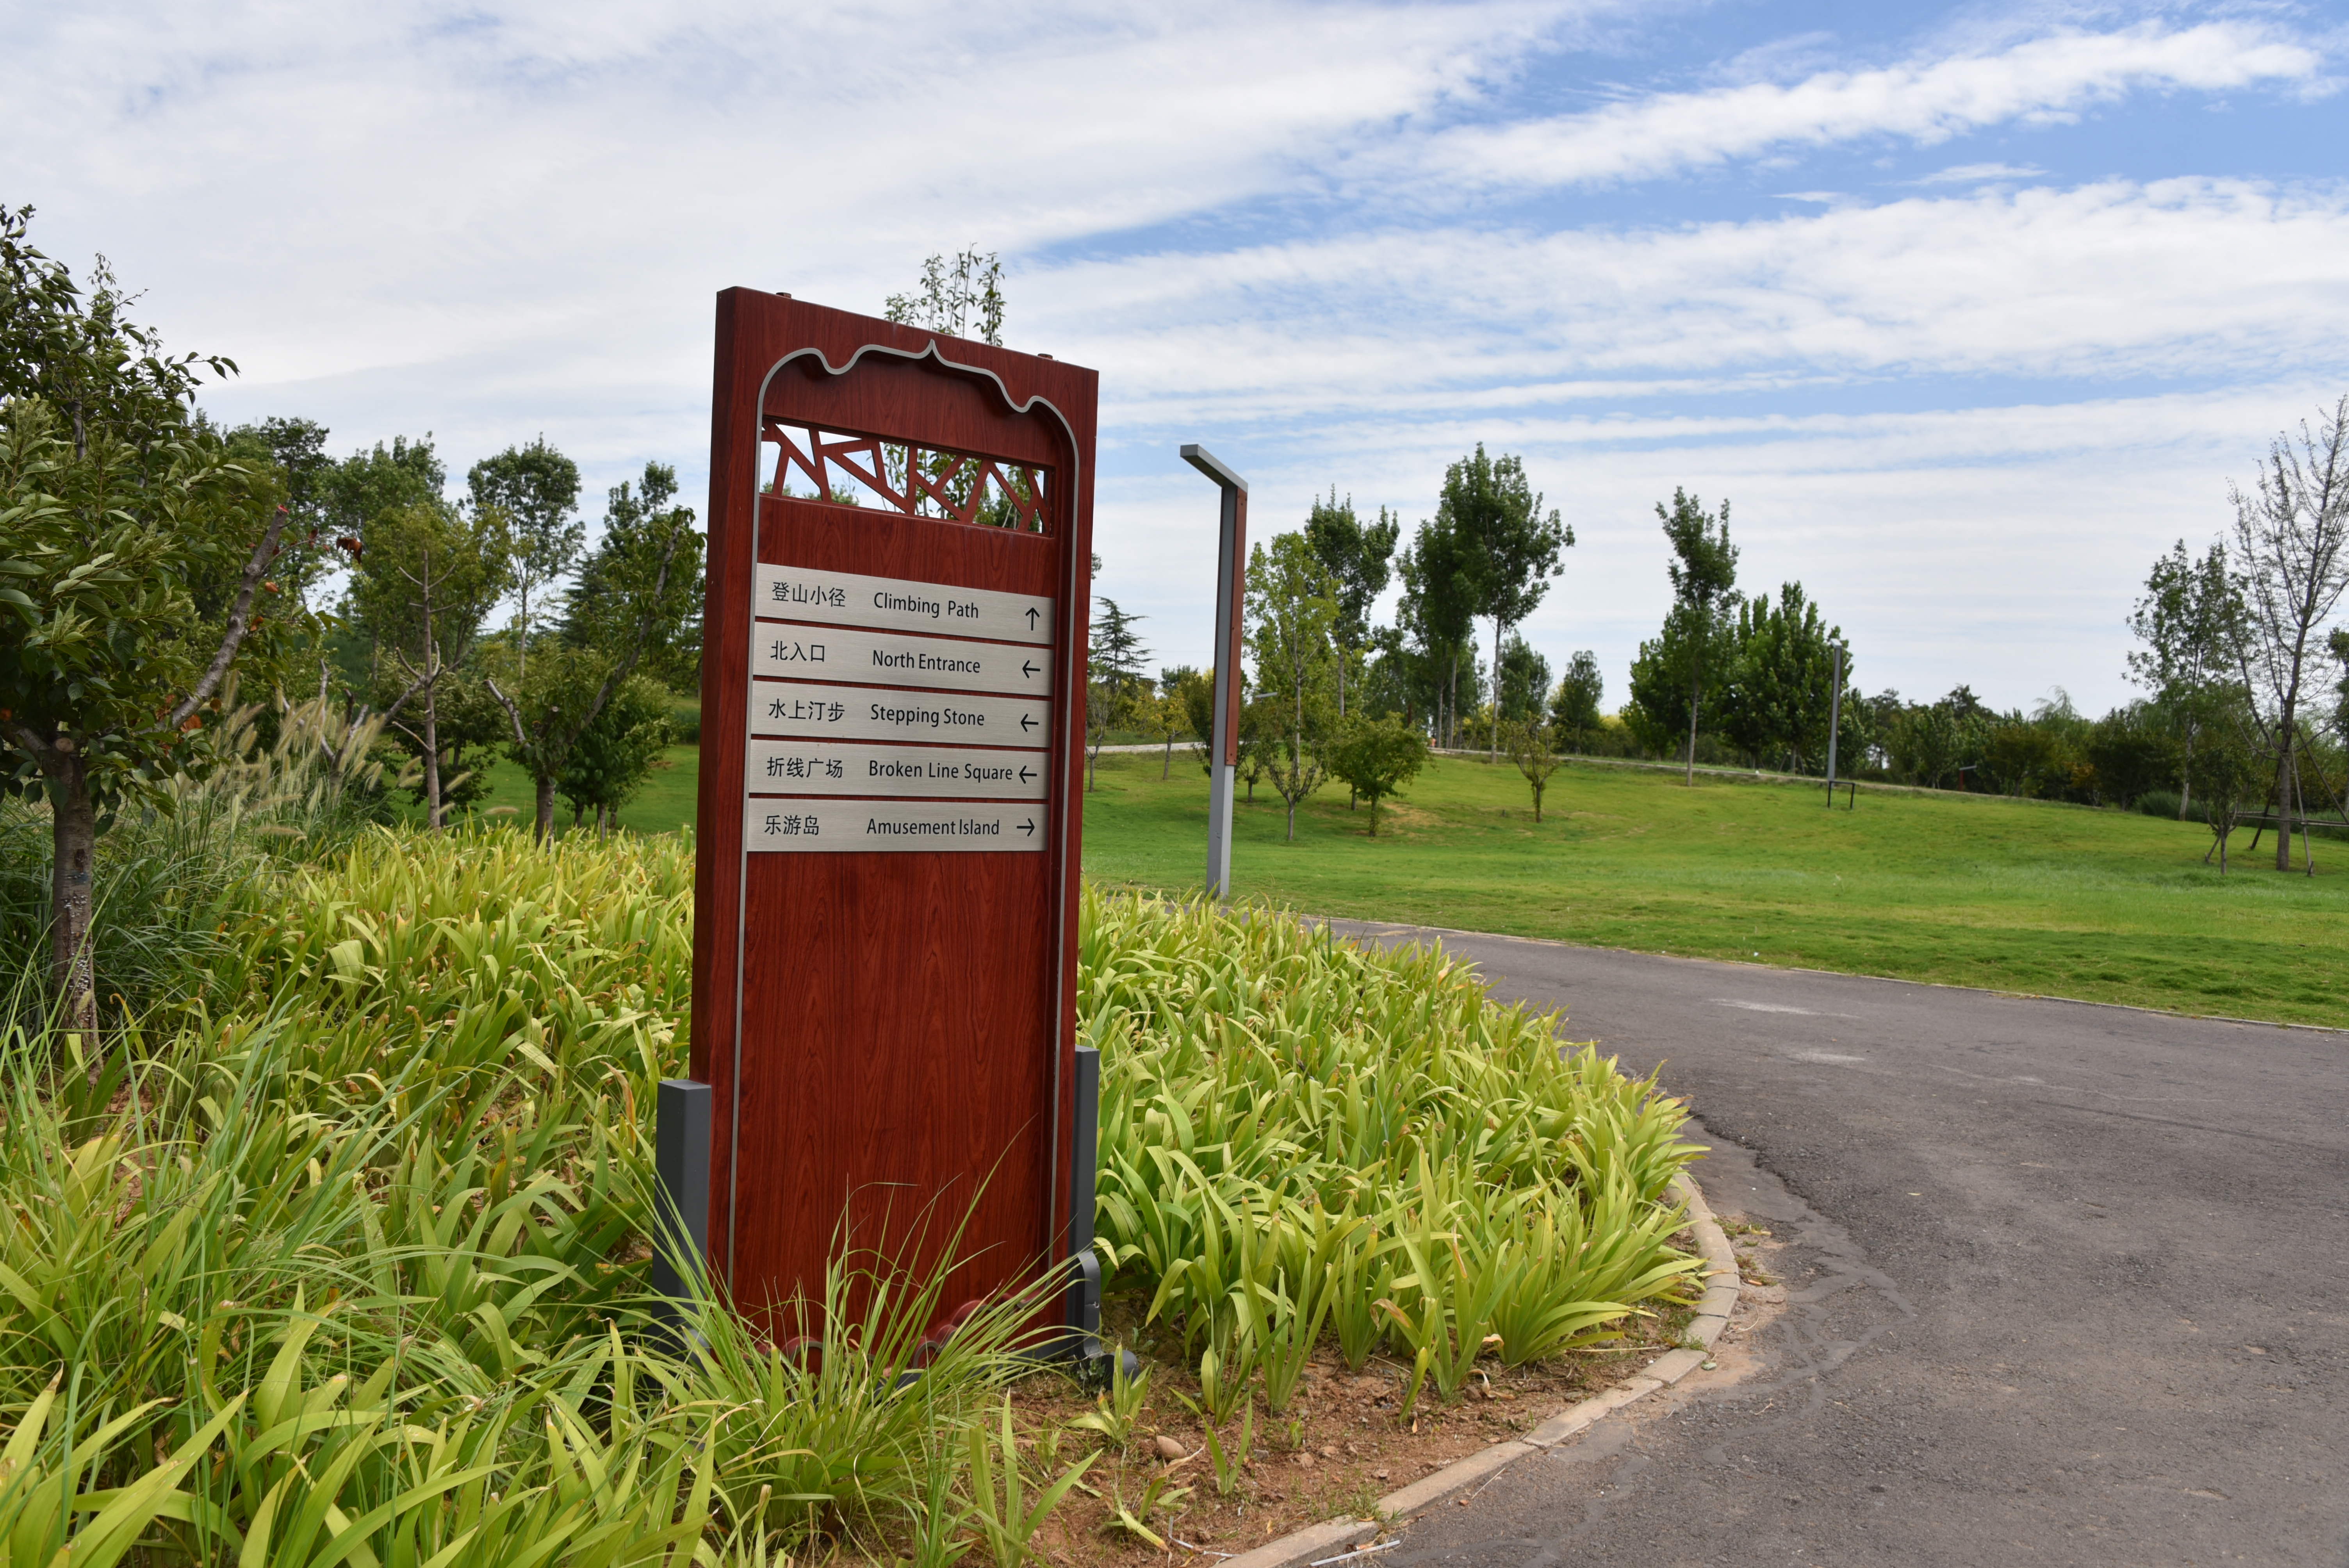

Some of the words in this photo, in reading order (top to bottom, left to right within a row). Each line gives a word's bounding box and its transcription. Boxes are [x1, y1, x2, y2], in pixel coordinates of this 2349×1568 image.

[772, 582, 846, 607] 登山小径
[874, 592, 939, 618] Climbing
[948, 600, 978, 618] Path
[770, 640, 825, 662] 北入口
[873, 650, 914, 668] North
[919, 653, 980, 673] Entrance
[768, 698, 845, 722] 水上汀步
[871, 704, 939, 727] Stepping
[943, 708, 984, 726] Stone
[766, 756, 843, 778] 折线广场
[869, 760, 922, 777] Broken
[929, 762, 959, 779] Line
[964, 763, 1013, 783] Square
[764, 815, 819, 836] 乐游岛
[866, 818, 956, 835] Amusement
[959, 819, 1000, 835] Island
